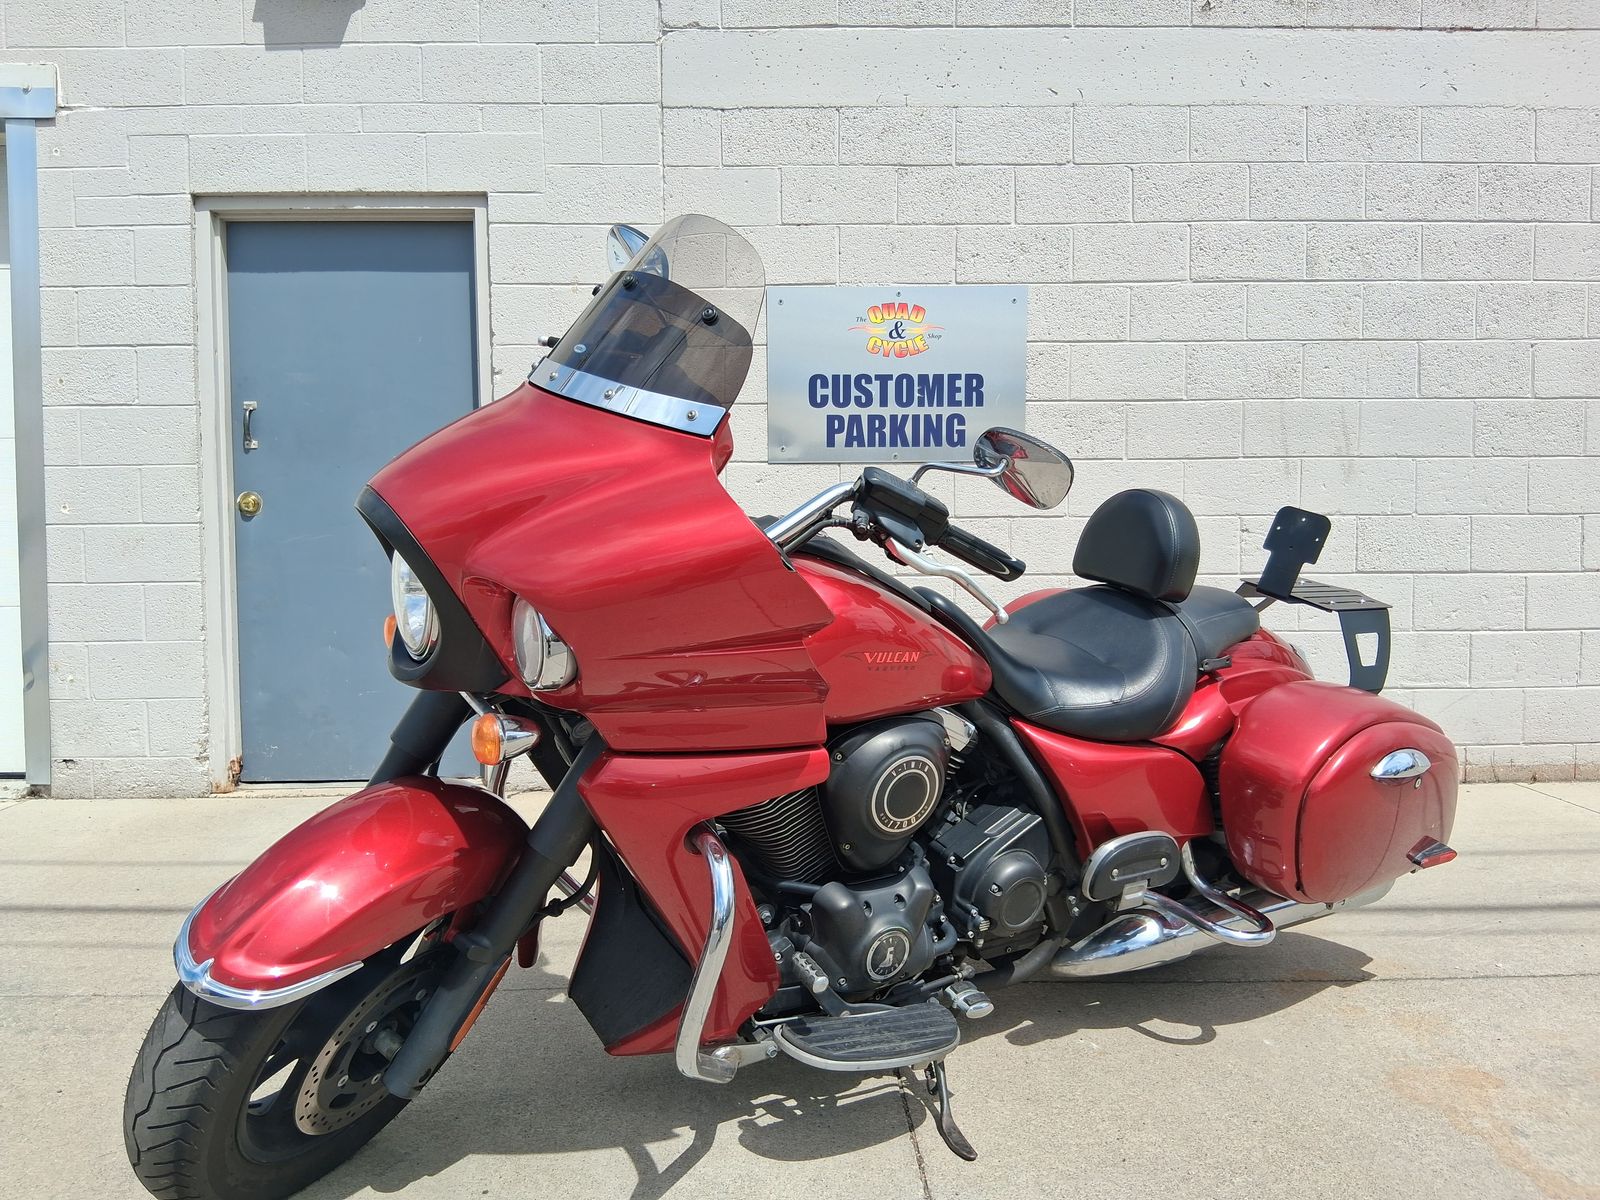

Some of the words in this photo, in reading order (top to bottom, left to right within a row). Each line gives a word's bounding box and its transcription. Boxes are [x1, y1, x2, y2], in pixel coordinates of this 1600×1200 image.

[867, 302, 926, 324] QUAD
[888, 320, 907, 340] &
[866, 334, 929, 358] CYCLE
[808, 373, 984, 408] CUSTOMER
[826, 413, 966, 448] PARKING
[864, 651, 920, 663] VULCAN
[887, 816, 916, 829] 1700
